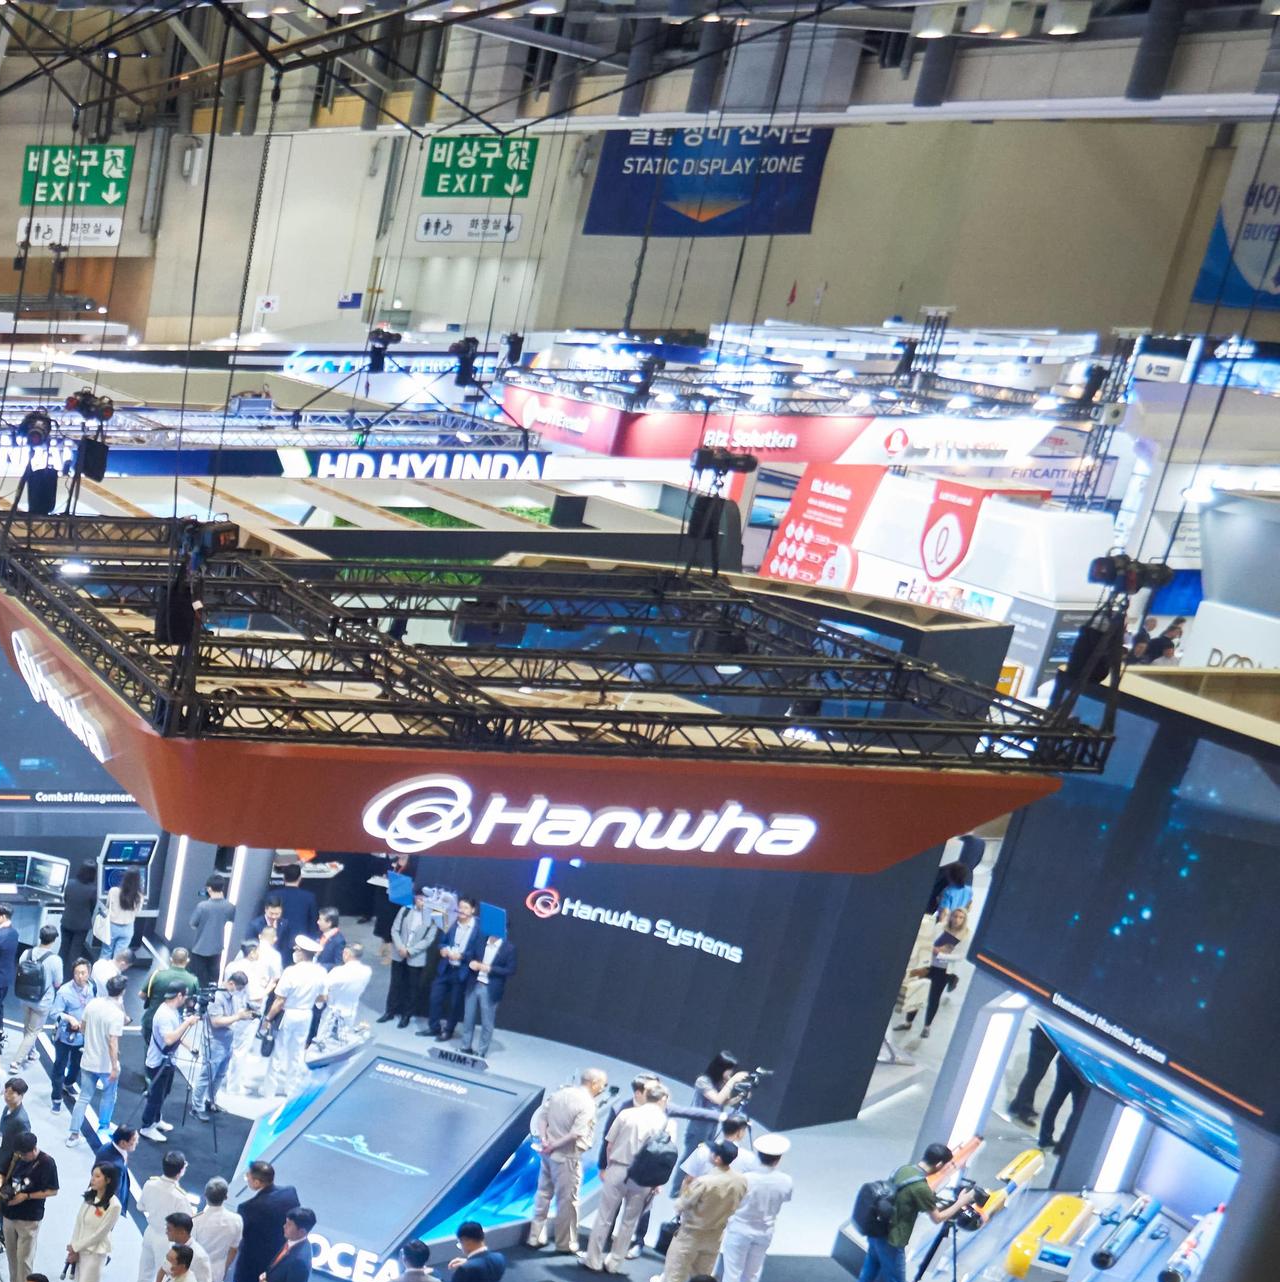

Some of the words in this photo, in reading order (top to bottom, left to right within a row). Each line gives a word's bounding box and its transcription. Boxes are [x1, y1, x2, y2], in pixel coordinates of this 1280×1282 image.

[27, 150, 100, 177] 비상구
[433, 141, 504, 168] 비상구
[623, 157, 680, 175] STATIC
[682, 157, 755, 175] DISPLAY
[34, 182, 90, 202] EXIT
[437, 175, 494, 193] EXIT
[317, 452, 376, 480] HD
[35, 791, 73, 803] Combat
[470, 794, 818, 856] Hanwha
[561, 897, 652, 935] Hanwha
[654, 918, 744, 964] Systems
[1052, 992, 1098, 1027] Unmanned
[1095, 1015, 1134, 1048] Maritime
[1132, 1037, 1167, 1065] System
[438, 1050, 478, 1069] MUM-T
[375, 1063, 414, 1080] SMART
[412, 1073, 468, 1095] Battleship
